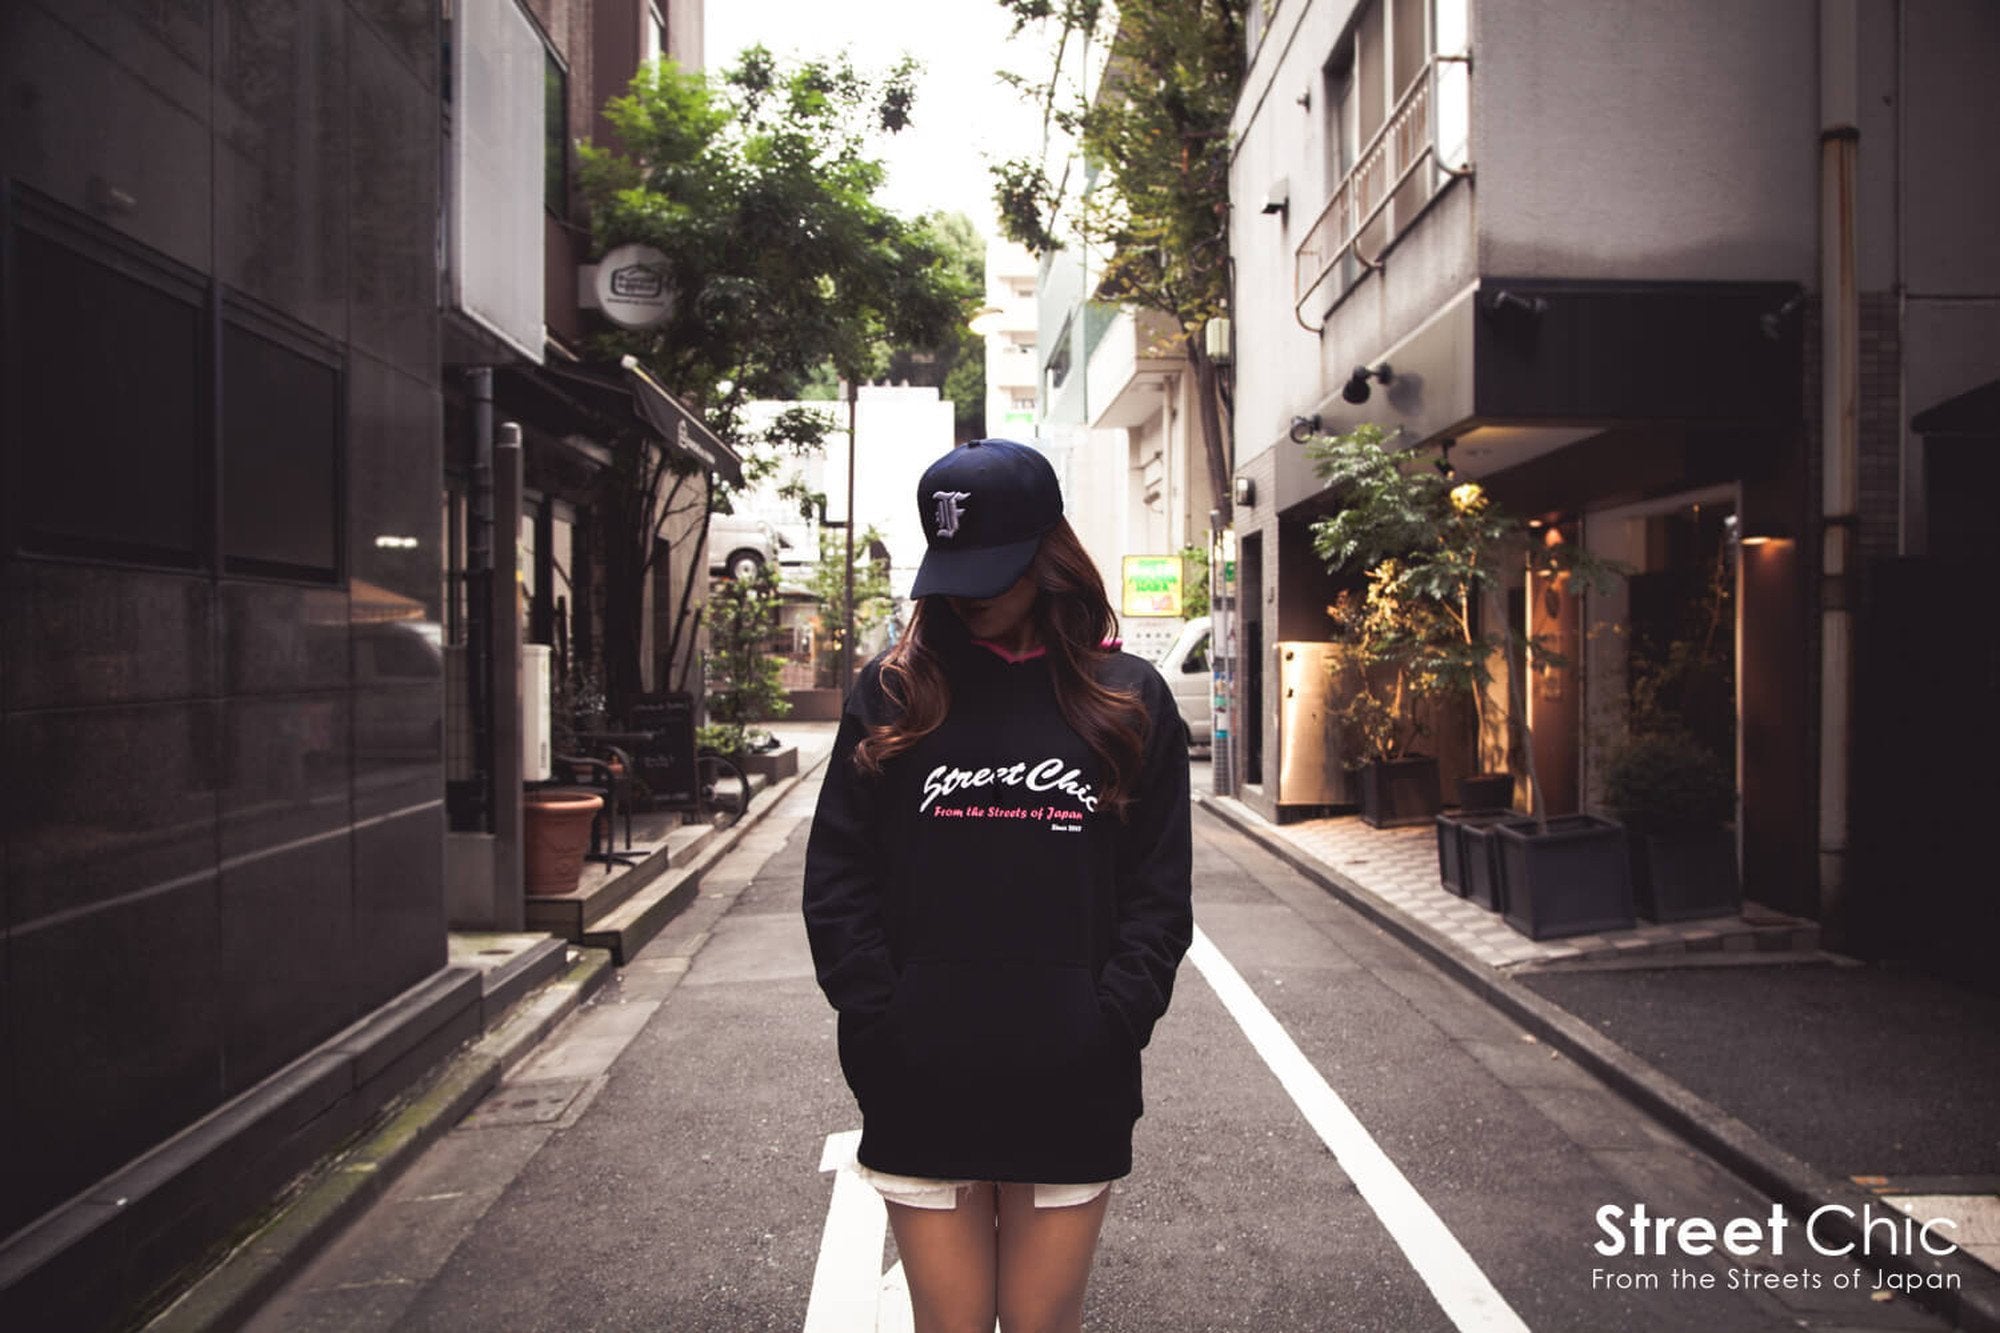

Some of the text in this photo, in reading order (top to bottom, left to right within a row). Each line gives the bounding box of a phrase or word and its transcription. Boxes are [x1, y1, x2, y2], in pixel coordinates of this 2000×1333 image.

[919, 758, 1098, 813] Street Chic
[934, 806, 1083, 820] From the Streets of Japan
